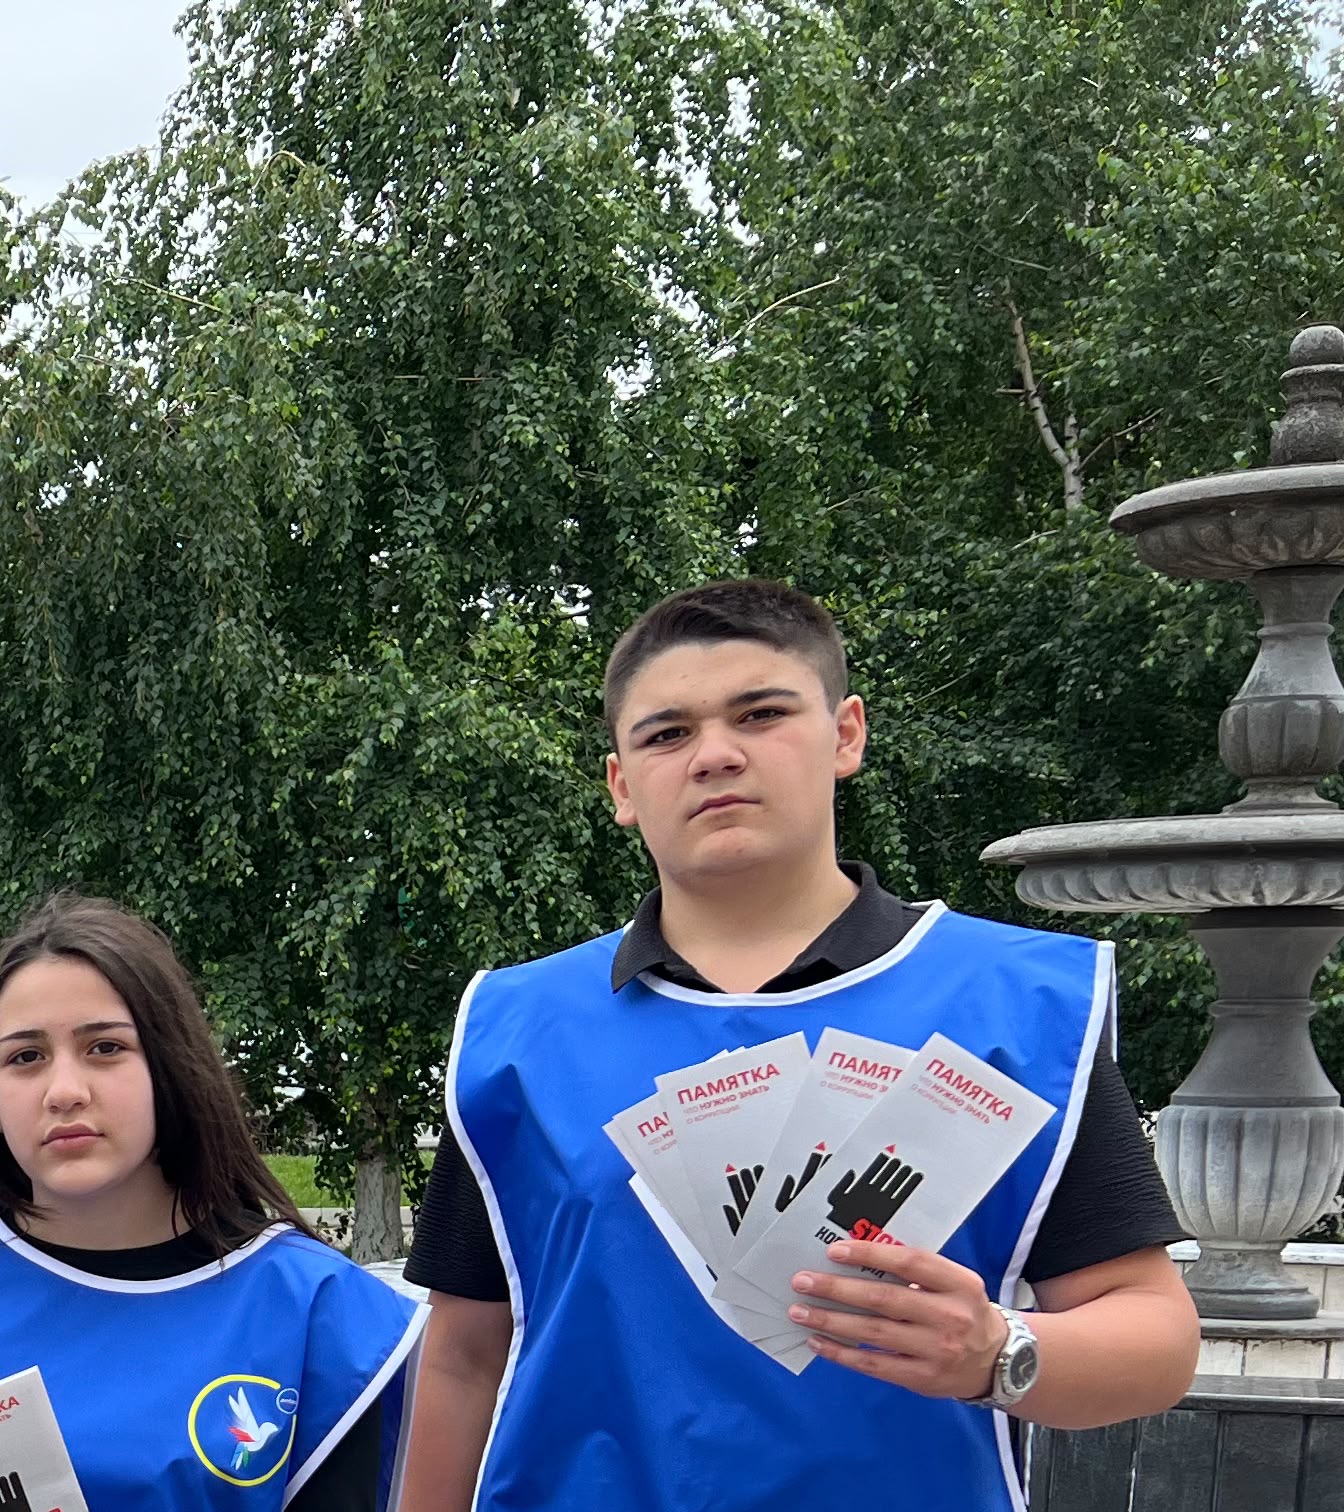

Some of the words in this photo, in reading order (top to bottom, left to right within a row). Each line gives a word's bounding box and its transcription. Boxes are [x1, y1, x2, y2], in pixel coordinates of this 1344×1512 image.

[677, 1063, 781, 1104] ПАМЯТКА
[828, 1051, 903, 1083] ПАМЯТ
[925, 1058, 1013, 1121] ПАМЯТКА
[848, 1218, 905, 1246] STO
